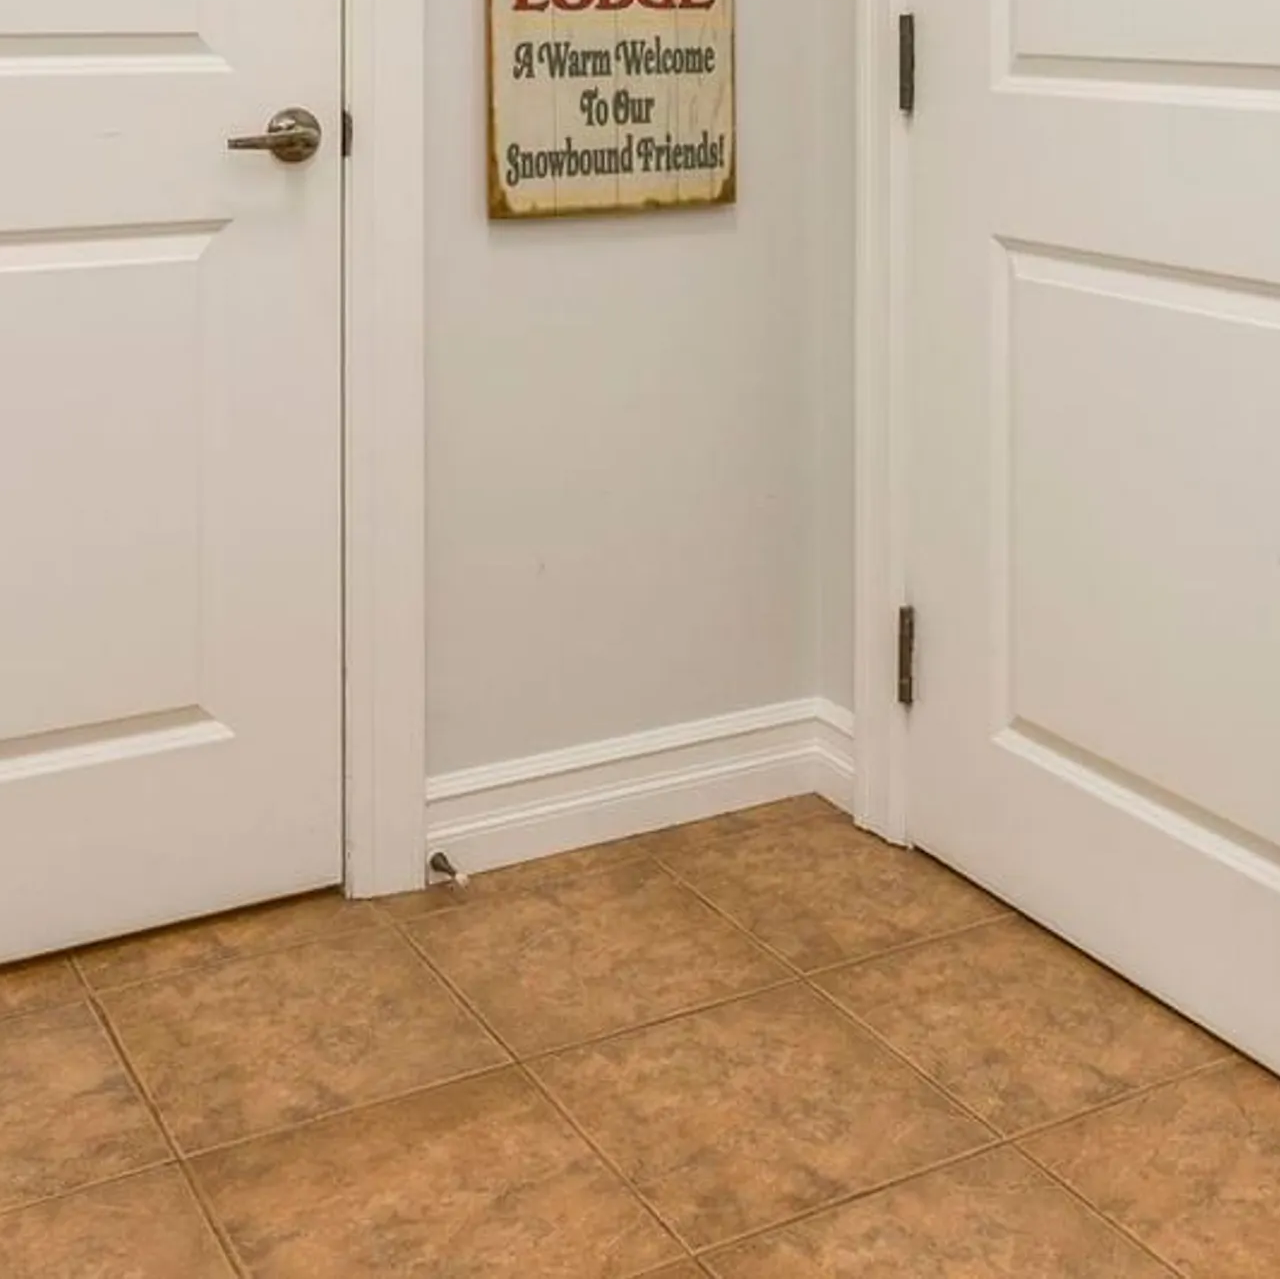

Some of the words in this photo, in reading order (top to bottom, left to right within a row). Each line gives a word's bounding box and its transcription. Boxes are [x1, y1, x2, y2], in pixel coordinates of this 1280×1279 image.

[513, 41, 535, 79] A
[538, 41, 612, 78] Warm
[616, 35, 716, 76] Welcome
[580, 86, 608, 126] To
[612, 88, 655, 125] Our
[506, 133, 634, 187] Snowbound
[636, 129, 725, 172] Friends!
